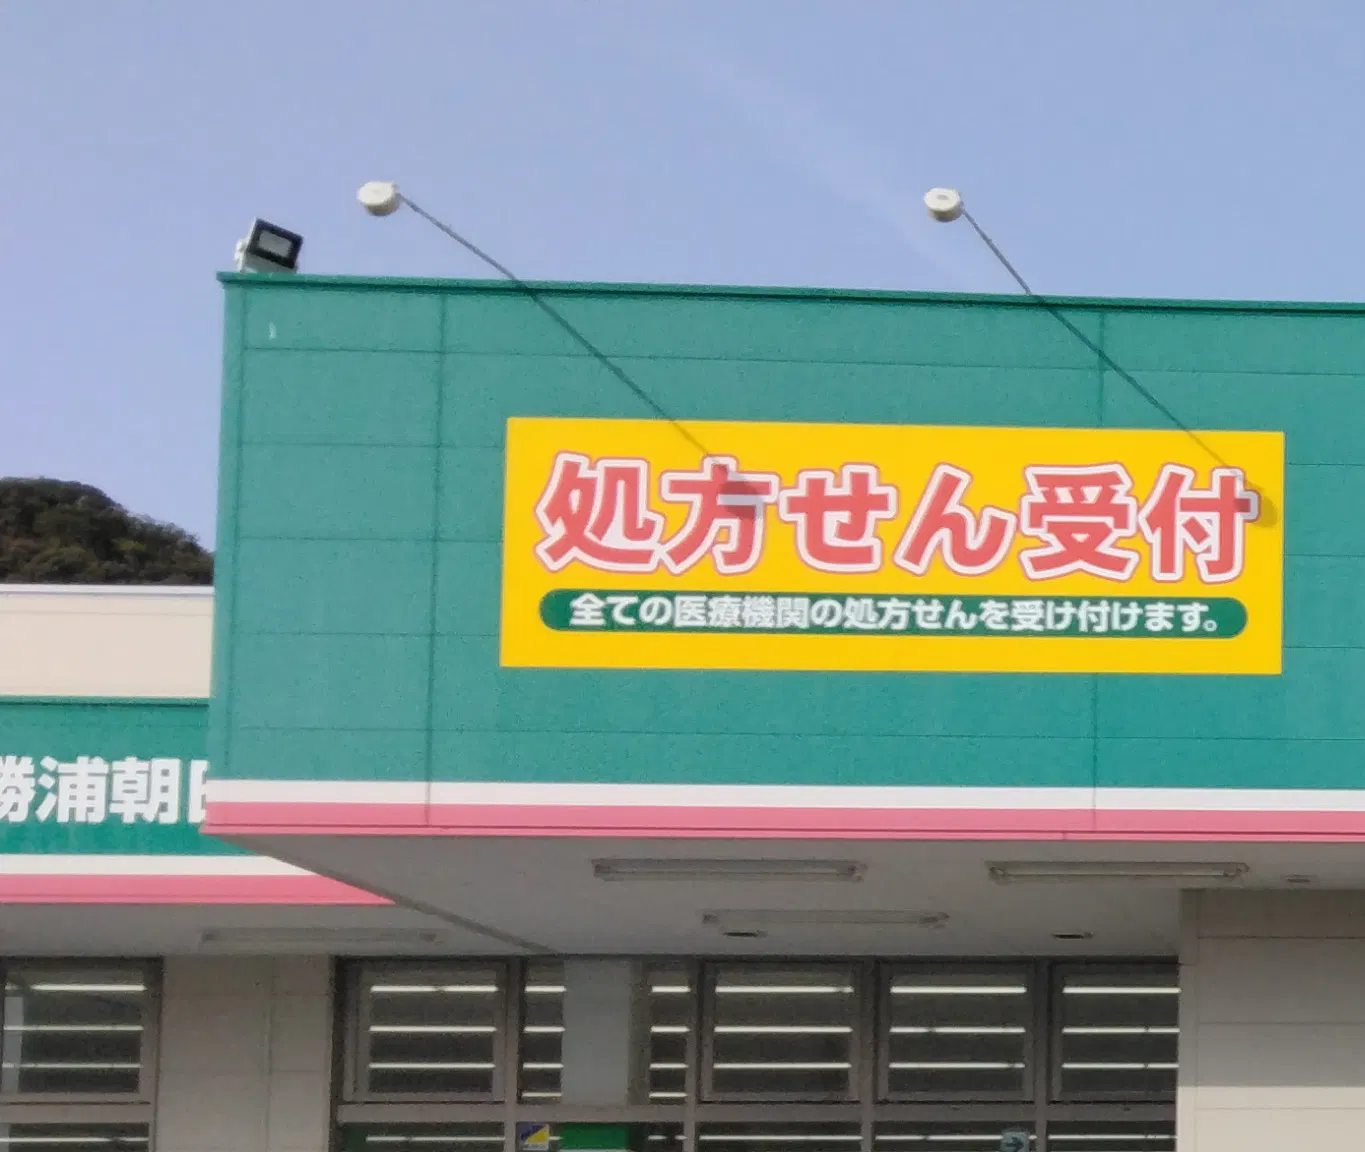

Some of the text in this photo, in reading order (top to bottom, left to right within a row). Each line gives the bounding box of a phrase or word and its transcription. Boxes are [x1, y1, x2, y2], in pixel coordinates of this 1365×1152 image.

[534, 451, 1262, 583] 処方せん受付
[569, 592, 1220, 634] 全ての医療機関の処方せんを受け付けます。
